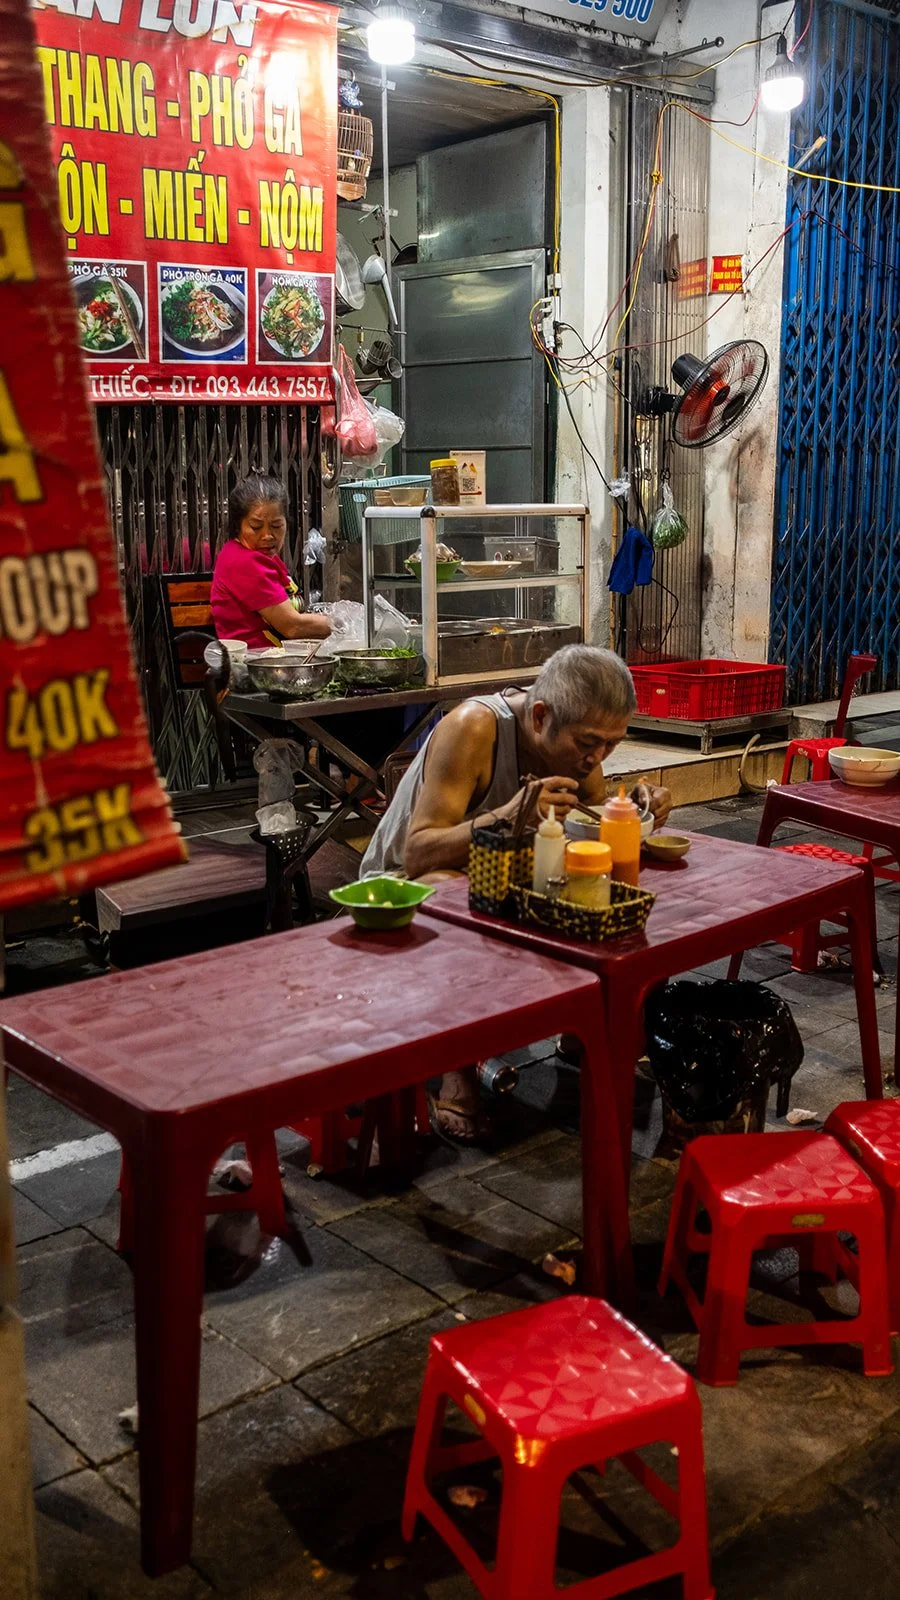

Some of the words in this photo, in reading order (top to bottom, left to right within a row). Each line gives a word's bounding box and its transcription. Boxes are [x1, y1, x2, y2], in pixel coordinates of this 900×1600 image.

[36, 46, 157, 138] THANG
[188, 53, 255, 150] PHỞ
[142, 150, 229, 245] MIẾN
[258, 168, 324, 265] NỘM
[68, 262, 91, 276] PHỞ
[92, 263, 109, 277] GÀ
[110, 266, 128, 278] 35K
[162, 265, 182, 281] PHỞ
[209, 269, 223, 283] GÀ
[225, 273, 243, 284] 40K
[89, 365, 149, 398] THIẾC
[170, 375, 200, 398] ĐT:
[206, 375, 327, 398] 093.443.7557
[7, 668, 121, 758] 40K
[24, 782, 145, 874] 35K
